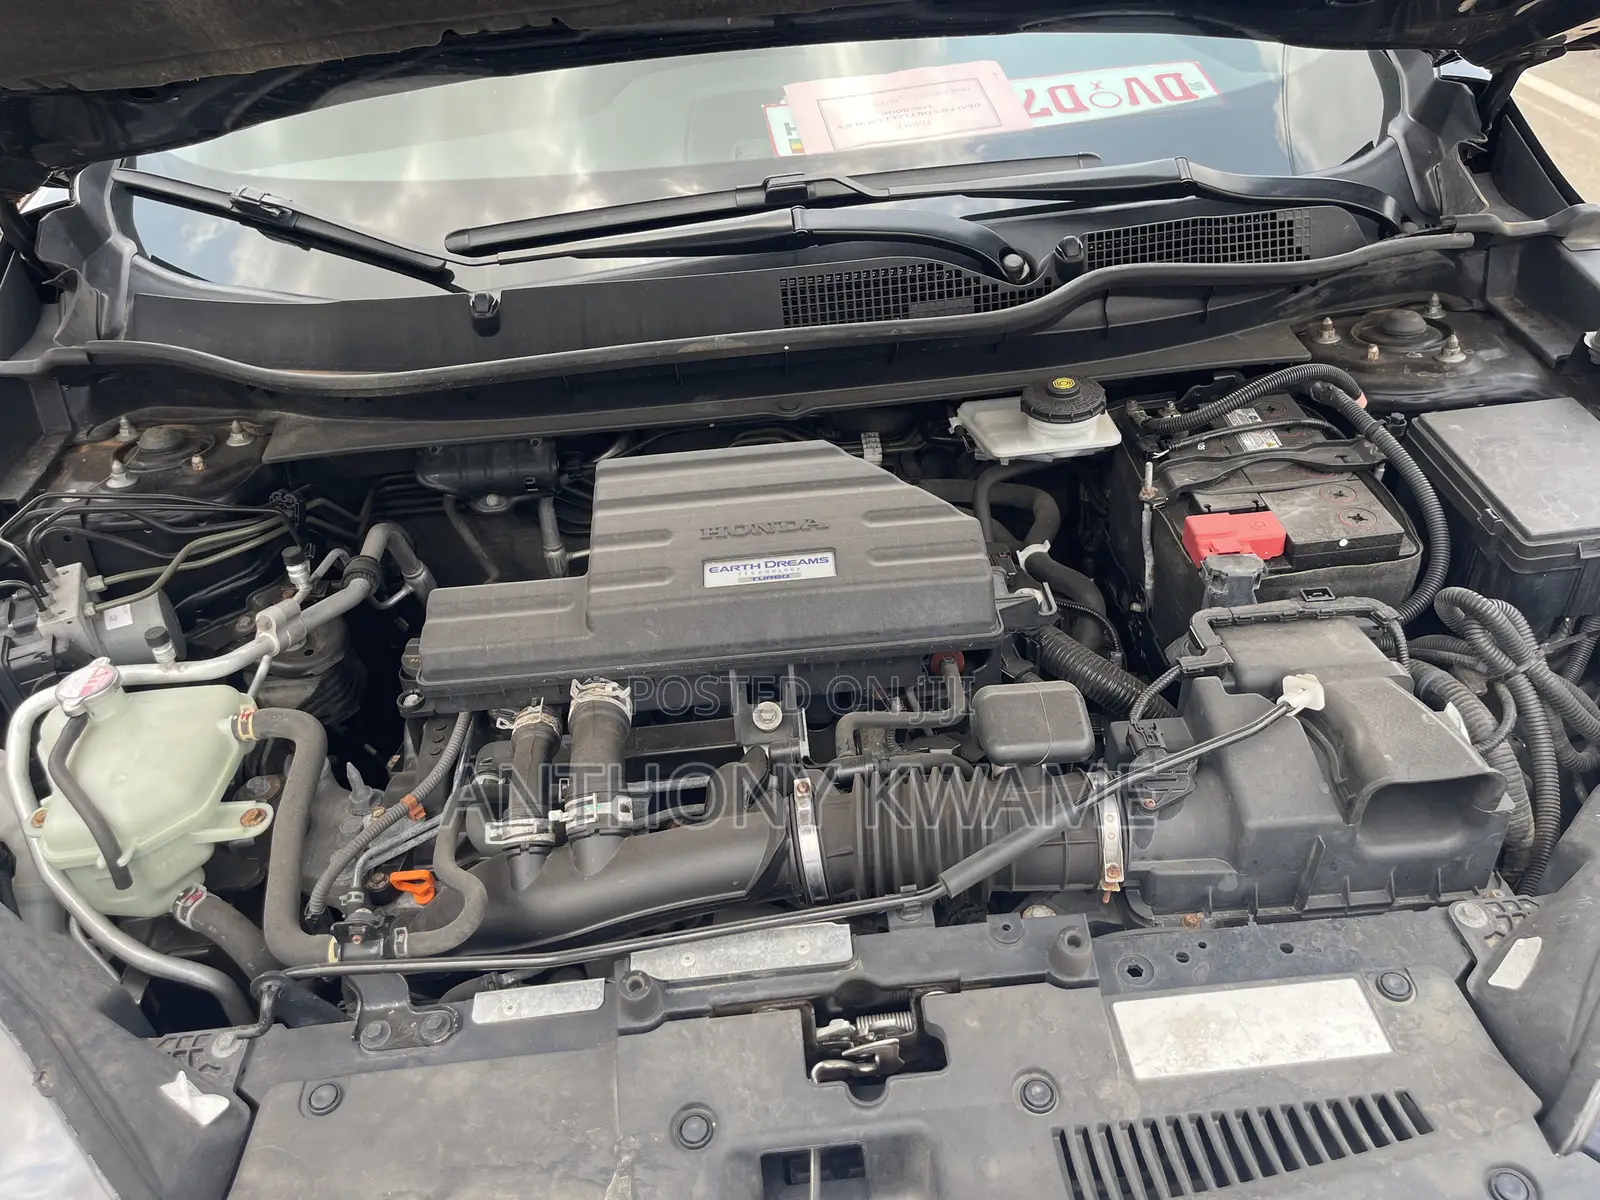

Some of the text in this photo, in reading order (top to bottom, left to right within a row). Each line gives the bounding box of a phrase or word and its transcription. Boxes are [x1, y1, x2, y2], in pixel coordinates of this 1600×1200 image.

[1124, 73, 1199, 106] DV
[881, 104, 933, 116] LOG BOOK
[700, 519, 829, 540] HONDA
[708, 556, 829, 574] EARTH DREAMS
[738, 567, 801, 576] TECHNOLOGY
[750, 573, 790, 582] TURBO
